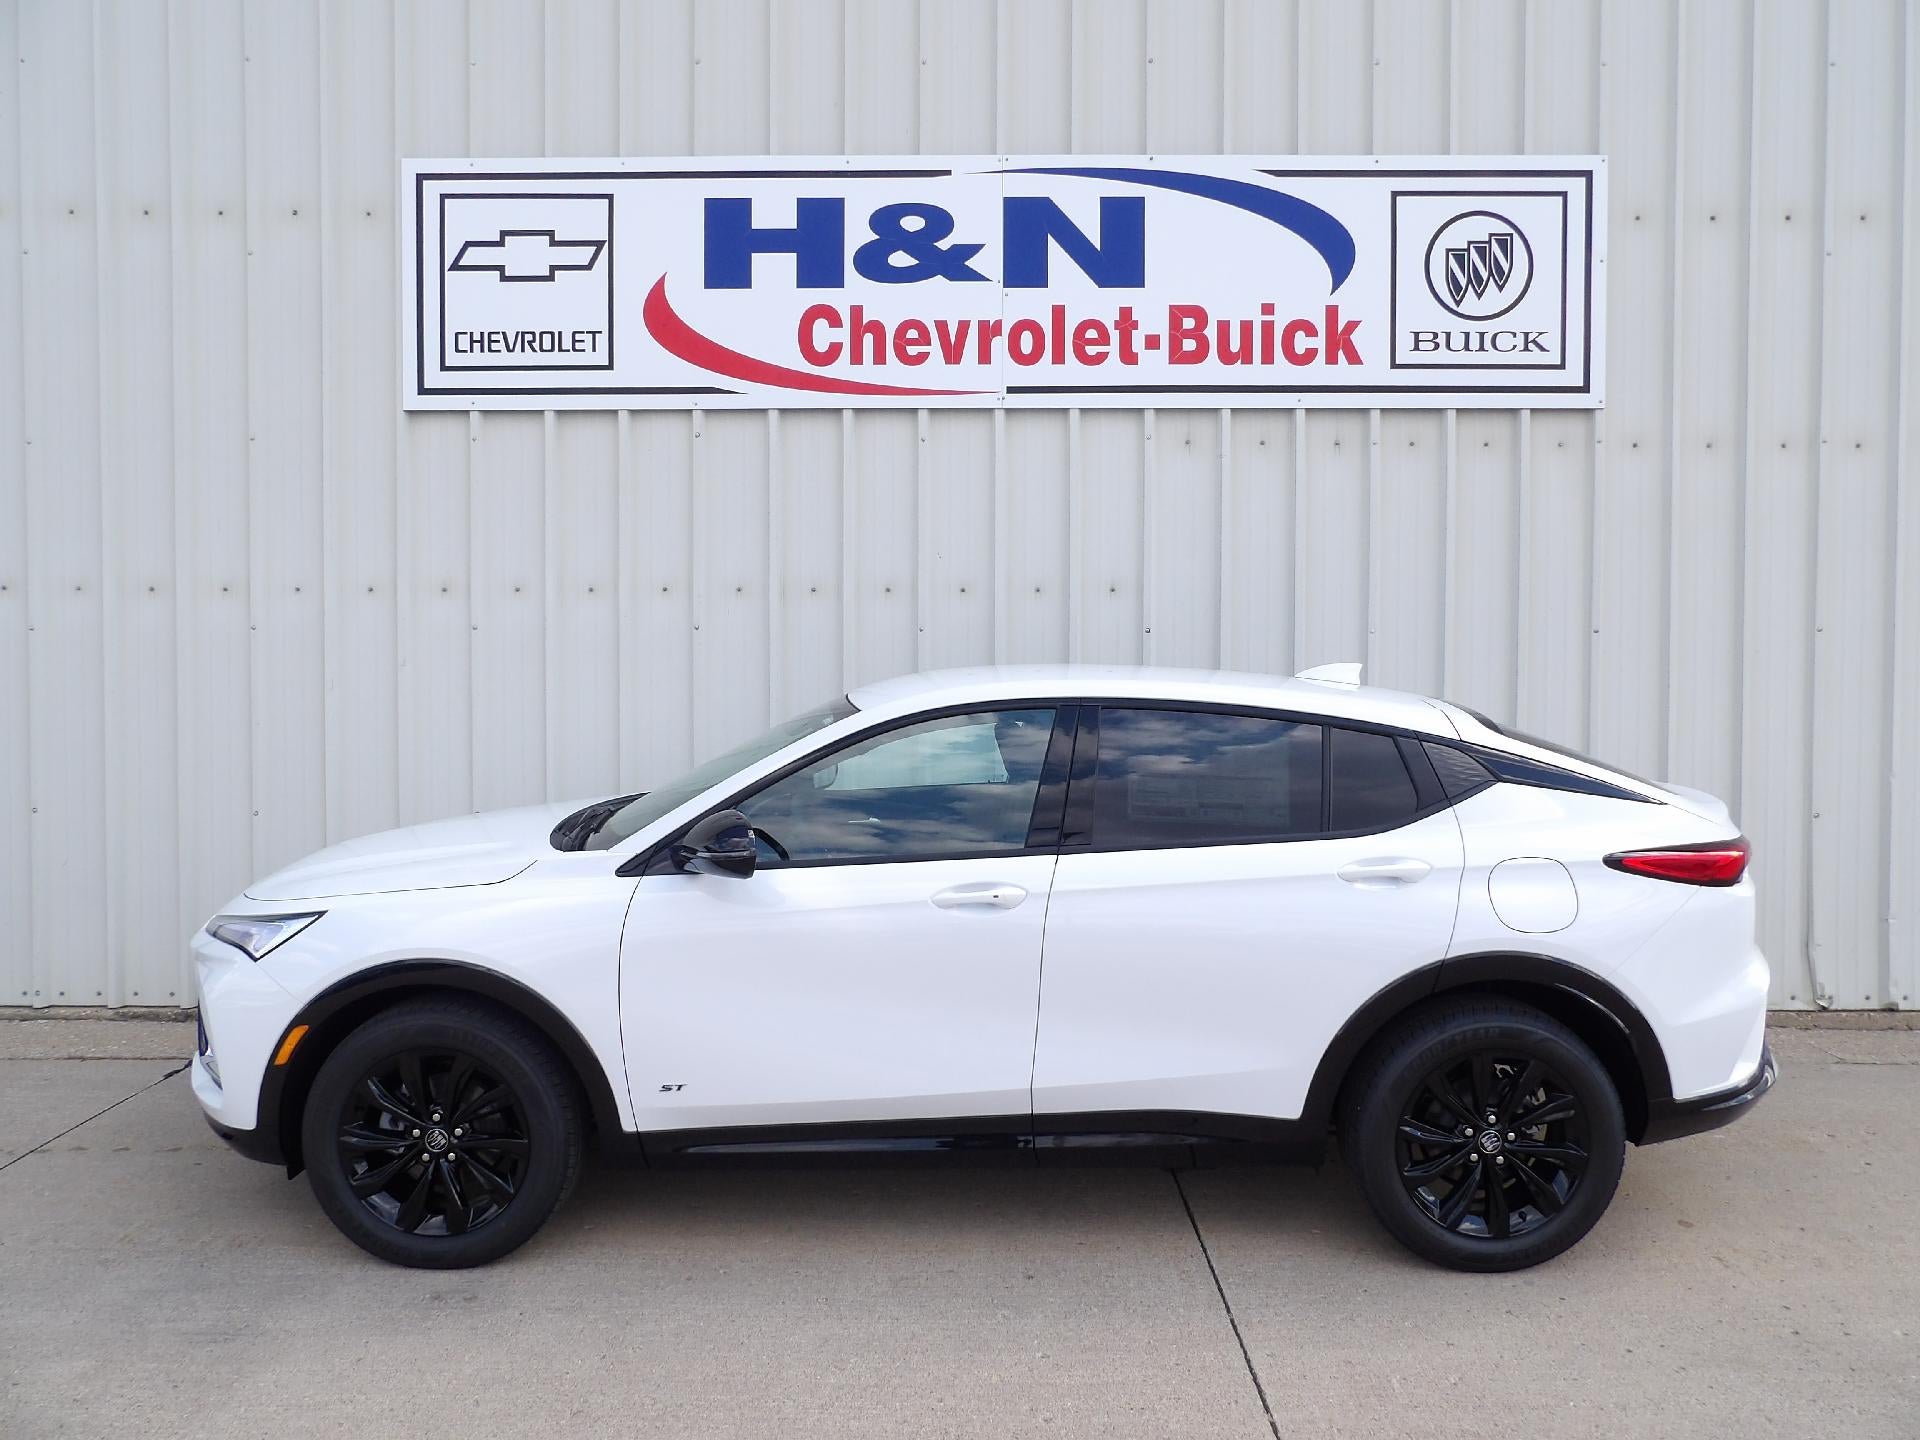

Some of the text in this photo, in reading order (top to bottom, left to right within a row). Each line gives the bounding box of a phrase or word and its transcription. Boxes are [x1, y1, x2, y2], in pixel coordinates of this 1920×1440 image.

[703, 196, 1146, 289] H&N
[454, 330, 603, 354] CHEVROLET
[797, 303, 1364, 367] Chevrolet-Buick
[1409, 330, 1550, 353] BUICK
[659, 1083, 688, 1092] ST
